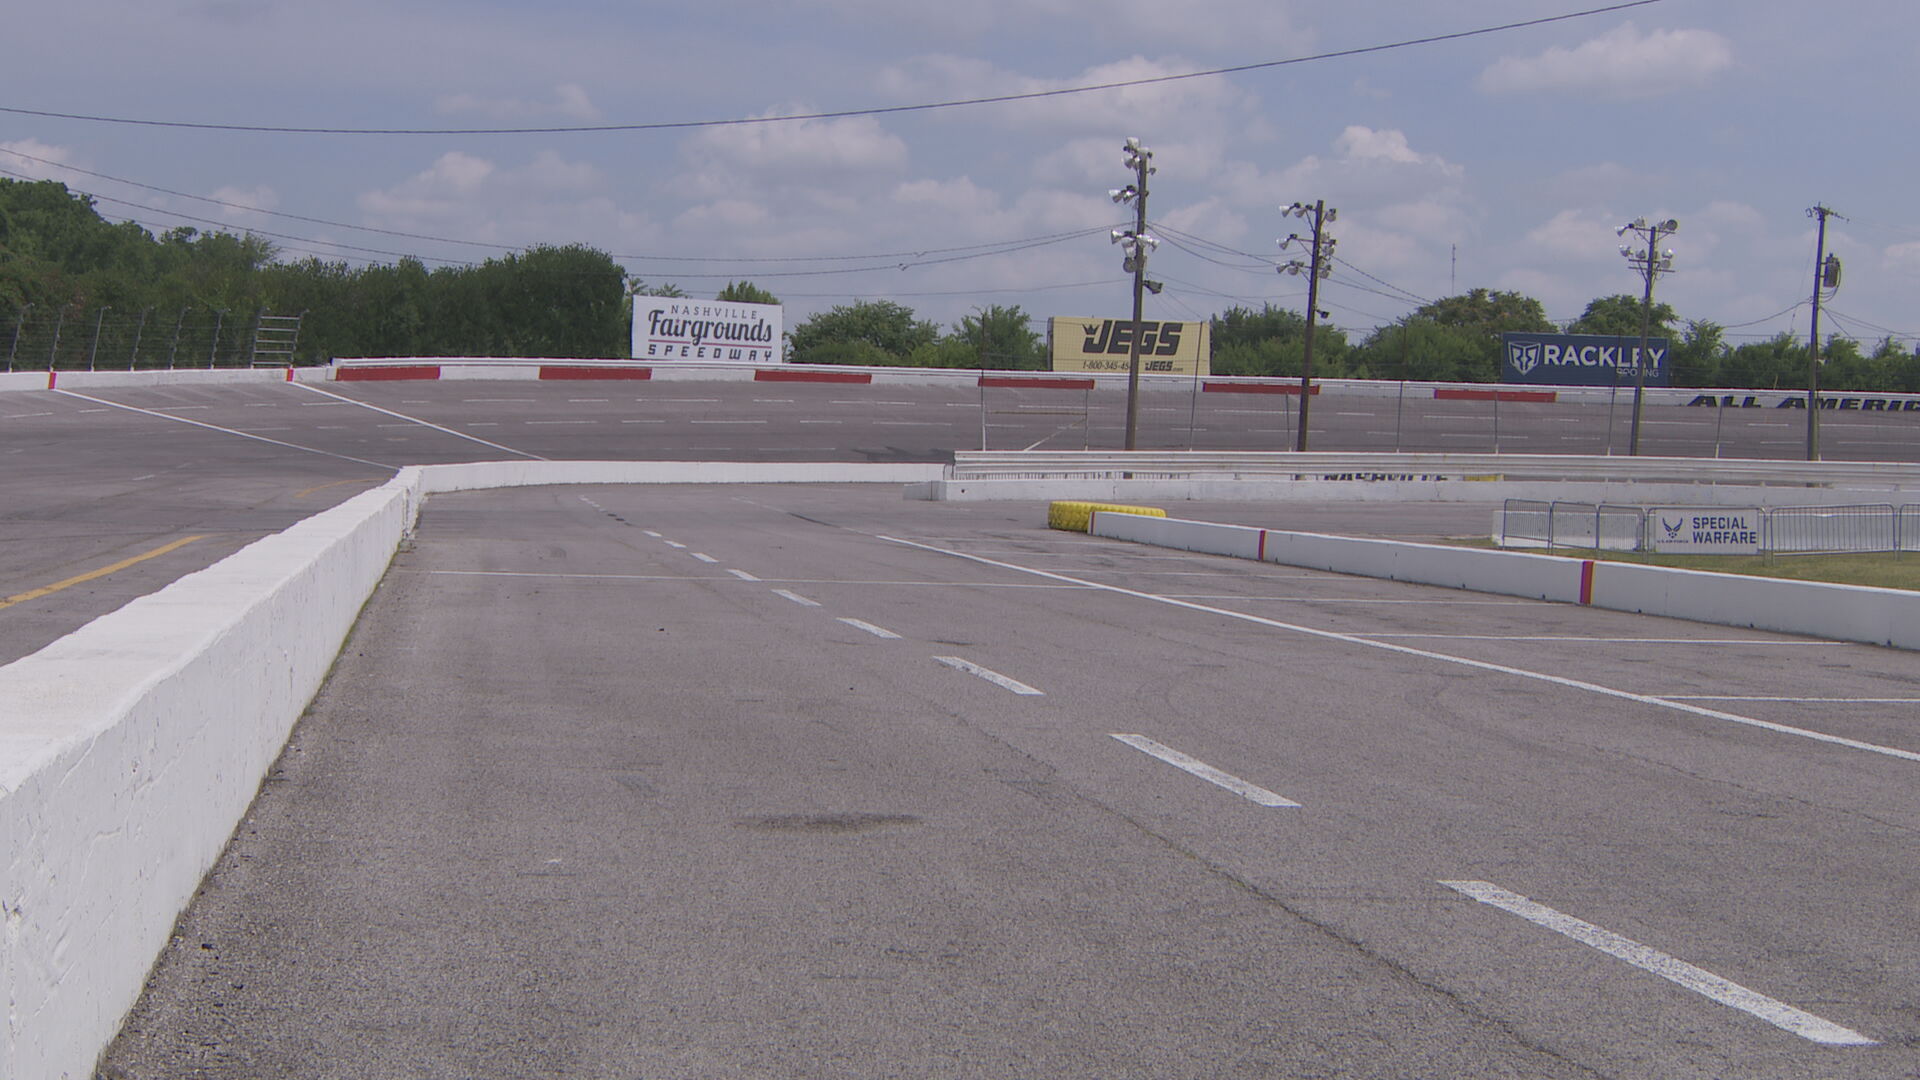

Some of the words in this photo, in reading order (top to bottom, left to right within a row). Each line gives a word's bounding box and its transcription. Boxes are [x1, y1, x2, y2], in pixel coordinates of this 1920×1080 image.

[671, 305, 758, 320] NASHVILLE
[648, 309, 772, 346] Fairgrounds
[1082, 319, 1184, 356] JEGS
[648, 344, 772, 361] SPEEDWAY
[1083, 360, 1130, 370] 1-800-345-45
[1687, 395, 1762, 409] ALL
[1692, 516, 1748, 530] SPECIAL
[1692, 531, 1757, 545] WARFARE
